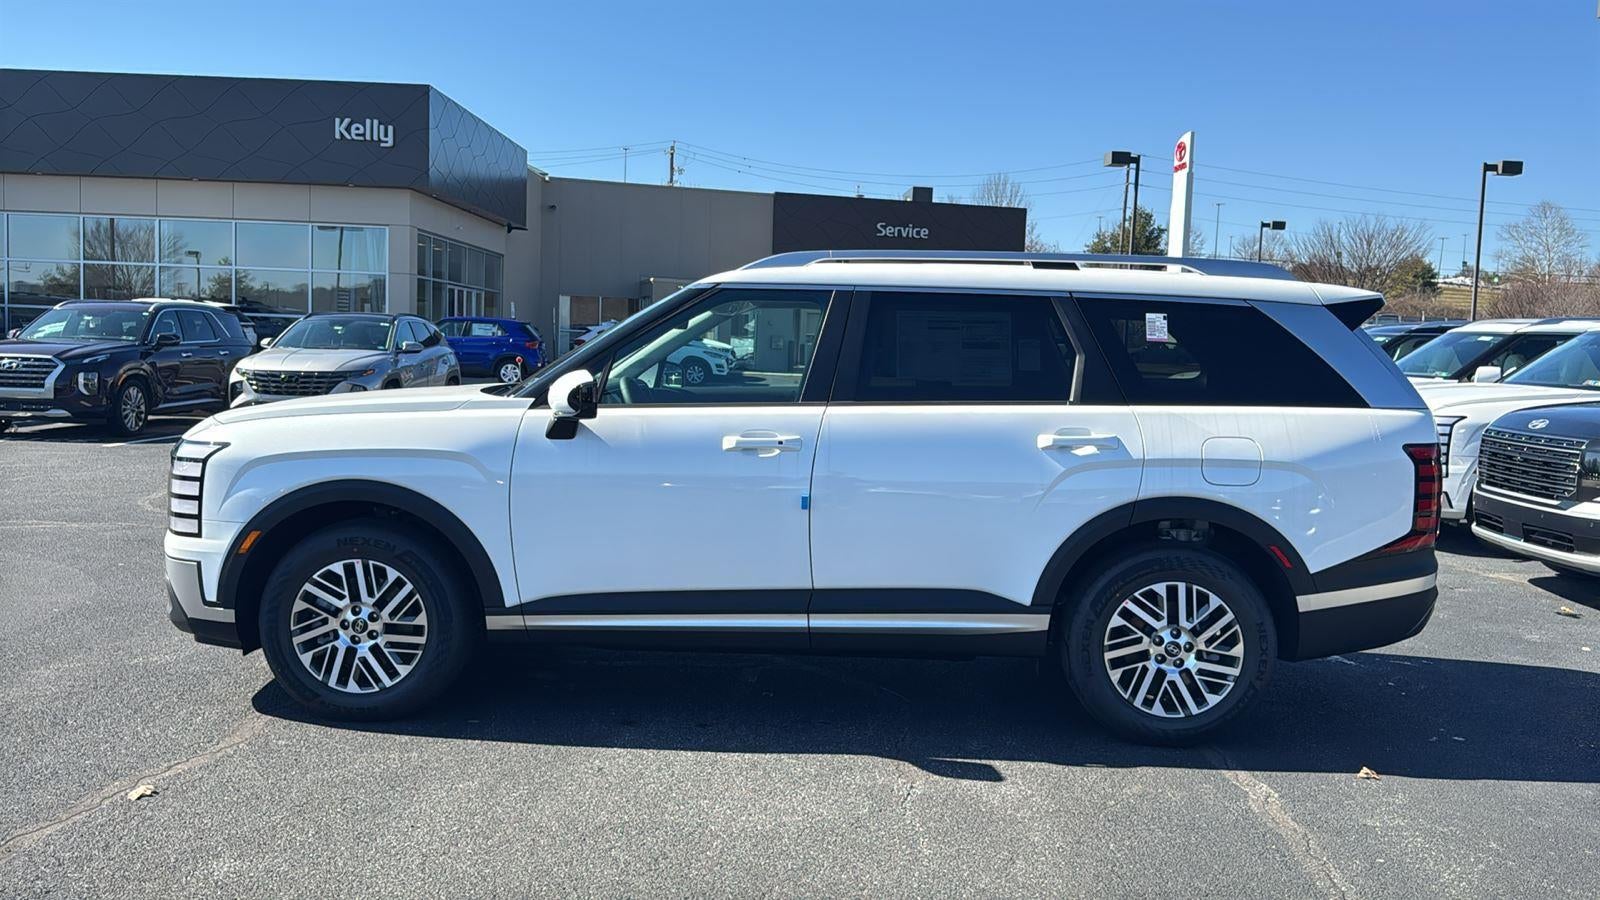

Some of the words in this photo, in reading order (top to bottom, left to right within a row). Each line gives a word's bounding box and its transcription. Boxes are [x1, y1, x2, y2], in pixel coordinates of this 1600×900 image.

[334, 117, 394, 147] Kelly
[876, 222, 929, 239] Service
[336, 536, 397, 554] NEXEN
